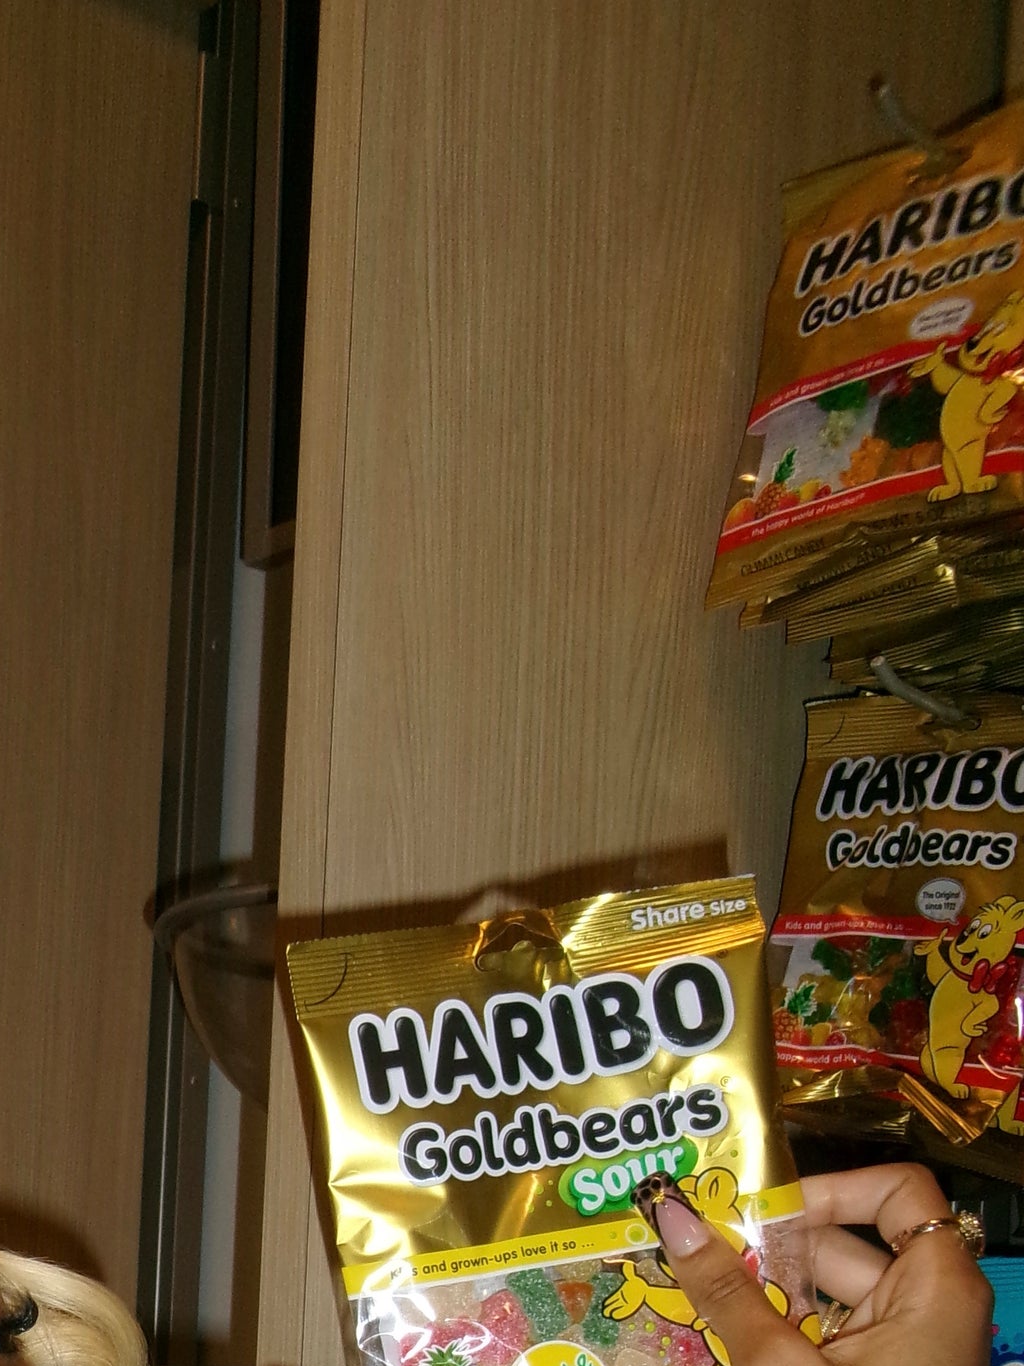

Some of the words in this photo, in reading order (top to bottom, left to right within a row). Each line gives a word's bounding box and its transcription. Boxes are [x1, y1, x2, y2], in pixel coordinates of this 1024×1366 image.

[800, 239, 1019, 335] Goldbears
[826, 824, 1015, 869] Goldbears
[631, 903, 705, 930] Share
[804, 920, 822, 930] and
[352, 959, 731, 1110] HARIBO
[401, 1085, 725, 1183] Goldbears
[423, 1259, 447, 1275] and
[451, 1249, 518, 1273] grown-ups
[521, 1246, 547, 1258] love
[550, 1241, 559, 1253] it
[562, 1240, 577, 1251] so
